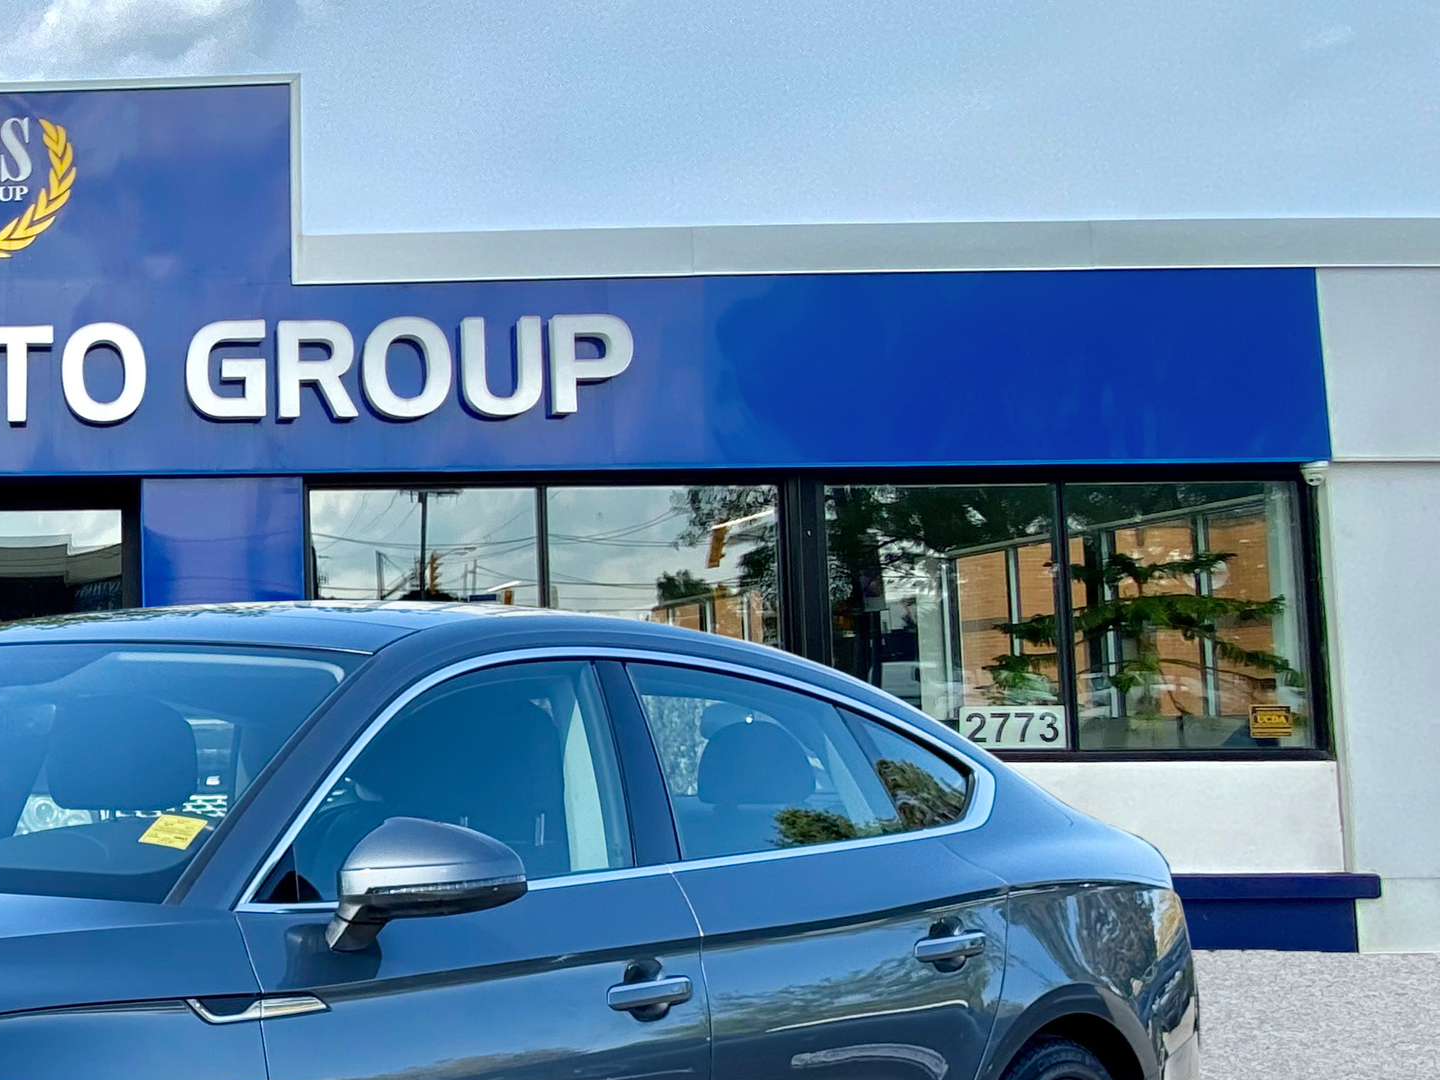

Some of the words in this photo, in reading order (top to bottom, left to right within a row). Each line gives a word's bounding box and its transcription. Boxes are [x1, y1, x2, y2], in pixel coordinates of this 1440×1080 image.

[184, 314, 635, 421] GROUP
[965, 712, 1059, 743] 2773
[1257, 715, 1287, 723] UCDA
